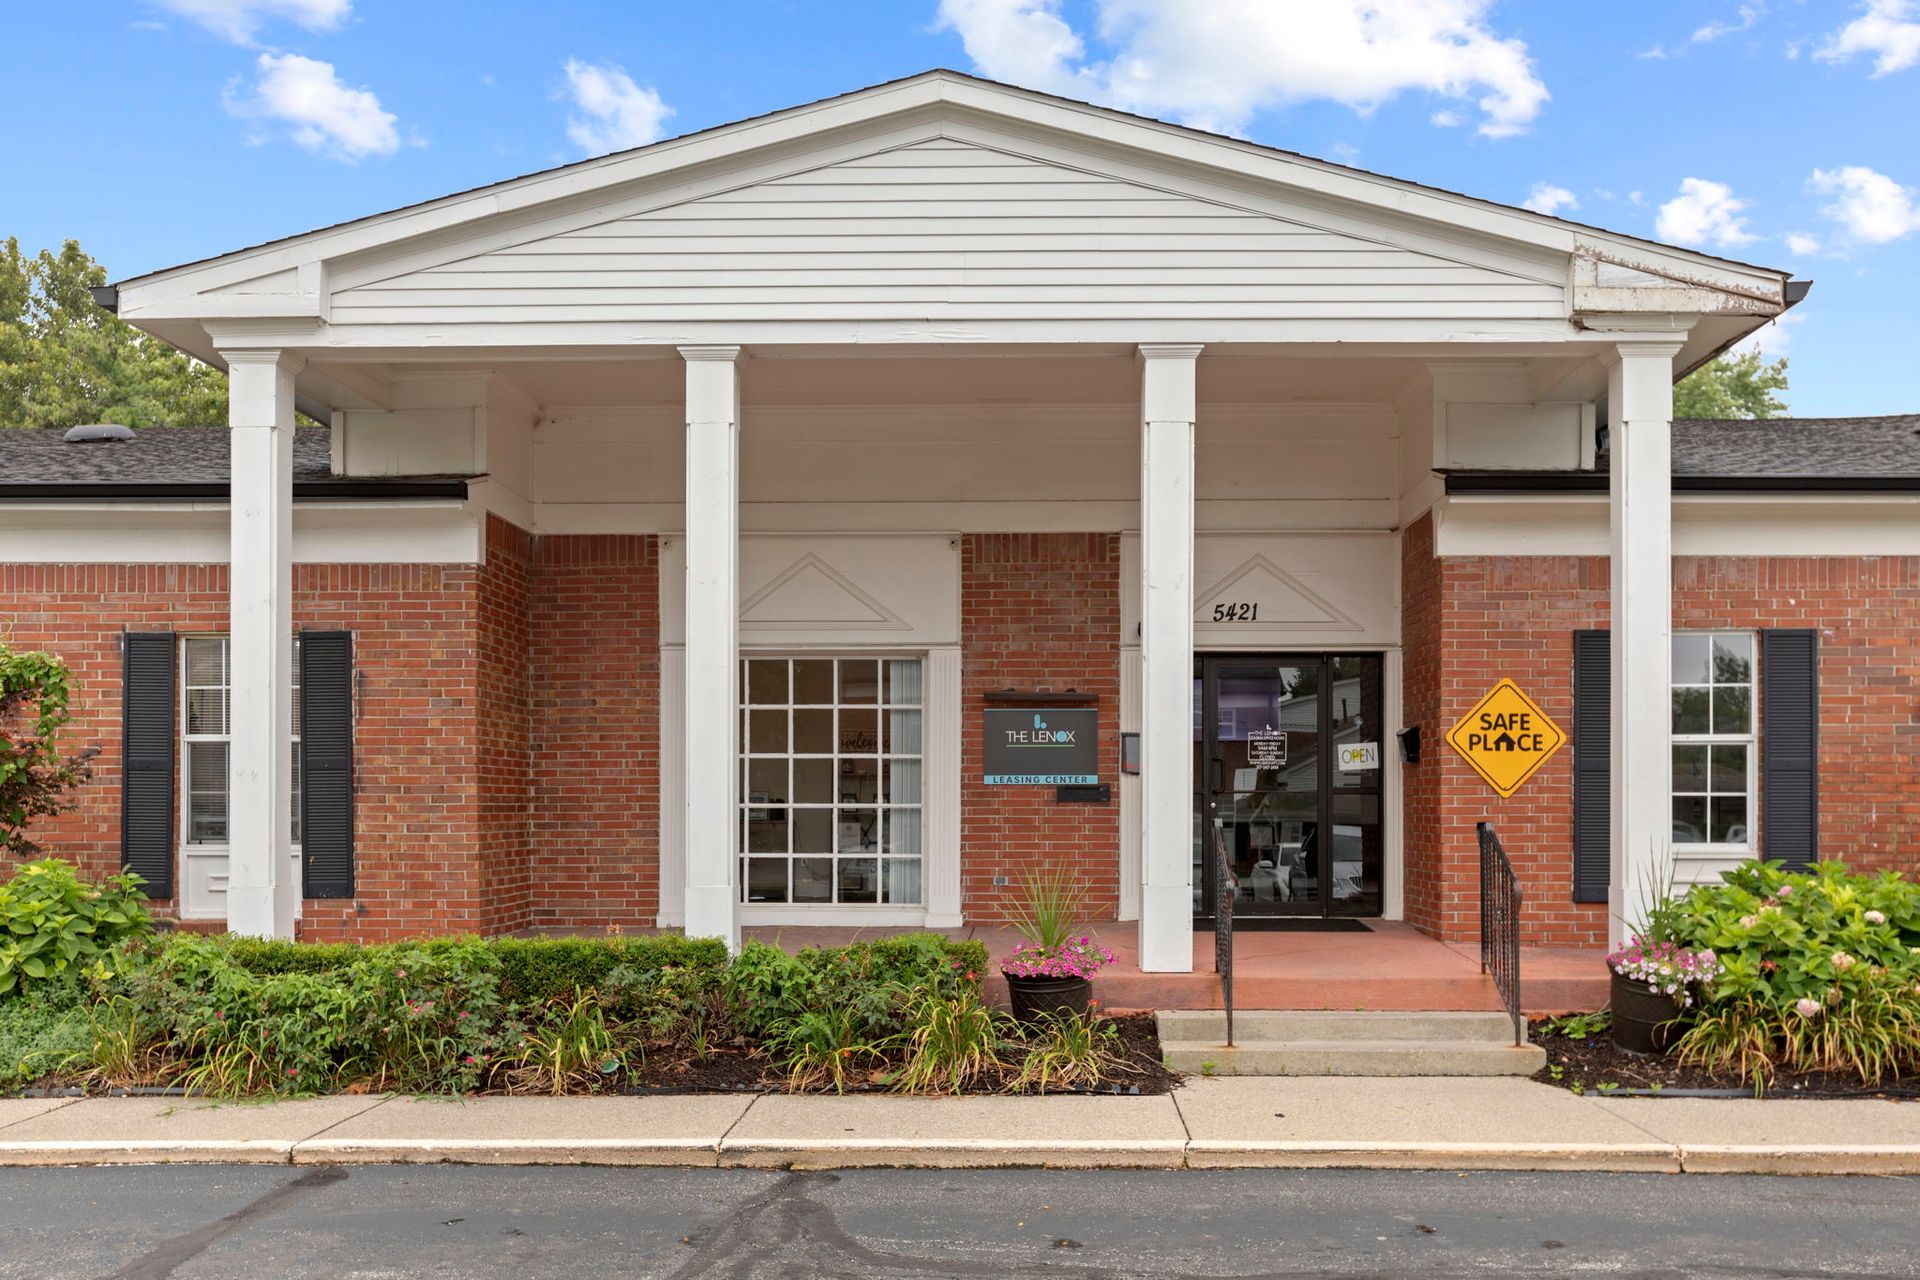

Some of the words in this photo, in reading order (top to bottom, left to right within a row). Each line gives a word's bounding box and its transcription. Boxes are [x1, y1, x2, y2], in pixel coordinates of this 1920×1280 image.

[1213, 602, 1258, 622] 5421
[1480, 713, 1531, 731] SAFE
[1005, 730, 1028, 743] THE
[1032, 730, 1076, 743] LENOX
[1468, 732, 1544, 752] PLACE
[1342, 748, 1375, 764] OPEN
[993, 776, 1040, 784] LEASING
[1045, 776, 1088, 784] CENTER
